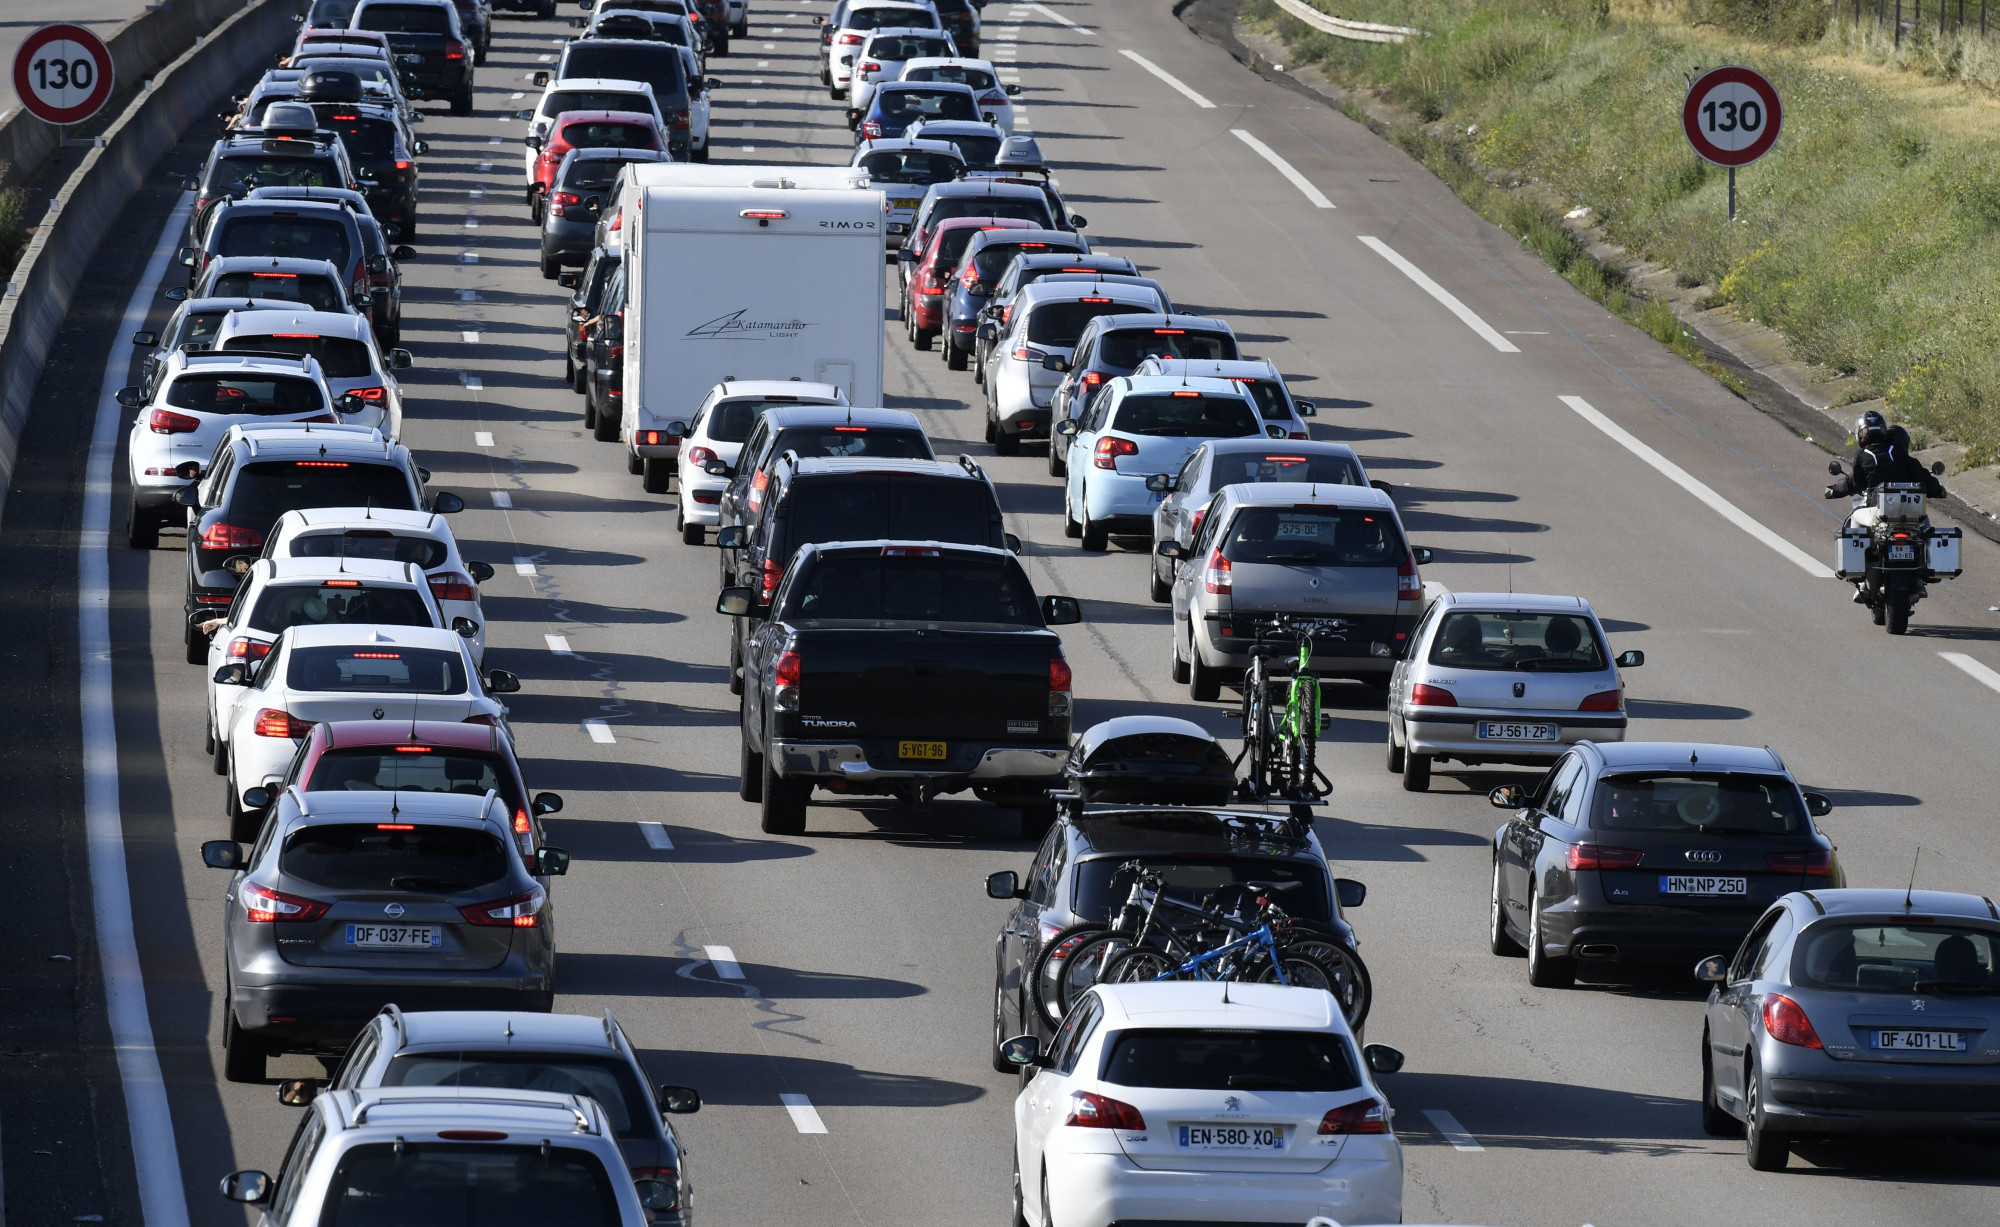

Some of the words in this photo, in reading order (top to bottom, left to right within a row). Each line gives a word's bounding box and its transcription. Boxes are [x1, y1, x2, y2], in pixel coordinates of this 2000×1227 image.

[34, 58, 93, 90] 130
[1703, 101, 1762, 132] 130
[819, 221, 876, 229] RIMOR
[735, 319, 806, 330] Katamarano
[801, 720, 858, 728] TUNDRA
[1488, 724, 1548, 739] EJ-561-ZP
[902, 743, 944, 757] 5-VGT-96
[1668, 877, 1687, 892] HN
[1697, 878, 1716, 892] NP
[1718, 879, 1745, 893] 250
[356, 927, 431, 944] DF-037-FE
[1881, 1032, 1957, 1049] DF-401-LL
[1190, 1128, 1274, 1146] EN-580-XQ
[1274, 1138, 1284, 1148] 71
